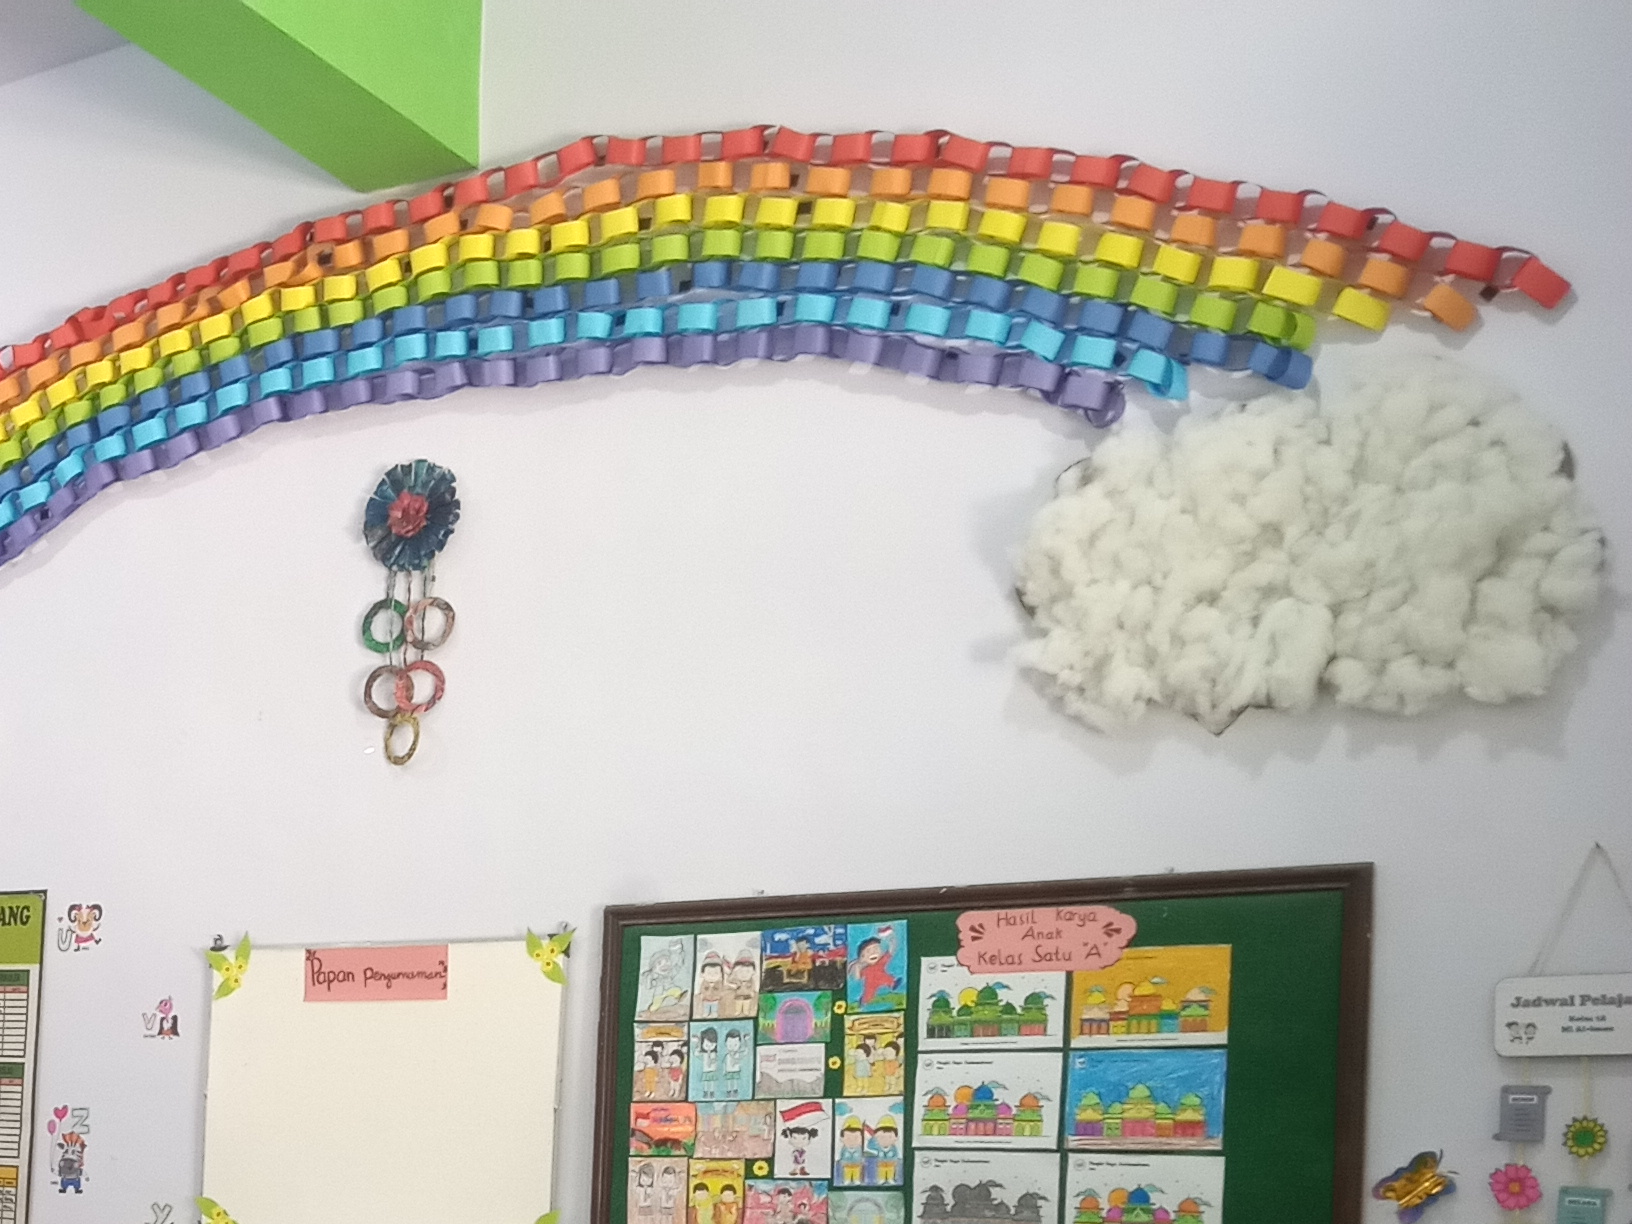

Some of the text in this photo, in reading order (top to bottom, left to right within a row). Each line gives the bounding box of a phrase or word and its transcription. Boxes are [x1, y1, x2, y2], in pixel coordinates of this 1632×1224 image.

[997, 908, 1098, 928] Hasil Karya
[58, 928, 72, 951] U
[1021, 926, 1063, 941] Anak
[977, 949, 1023, 966] Kelas
[1031, 944, 1073, 963] Satu
[311, 957, 355, 992] Papan
[1511, 996, 1576, 1009] Jadwal
[142, 1013, 157, 1030] V
[71, 1107, 90, 1135] Z
